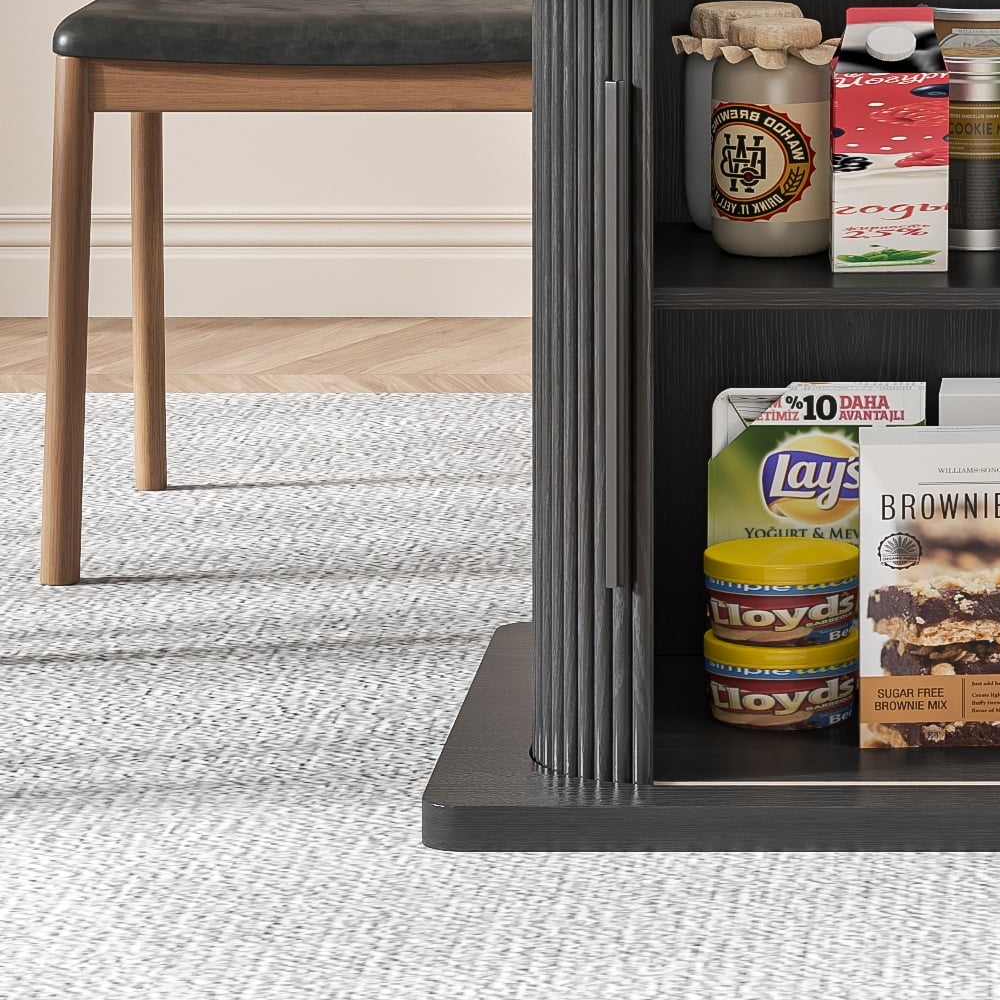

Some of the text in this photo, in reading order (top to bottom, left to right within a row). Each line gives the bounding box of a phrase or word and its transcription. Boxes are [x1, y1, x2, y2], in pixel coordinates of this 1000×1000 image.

[785, 394, 838, 421] %10
[839, 395, 890, 409] DAHA
[838, 409, 906, 422] AVANTAJLI
[877, 687, 945, 699] SUGAR FREE
[874, 700, 948, 712] BROWNIE MIX
